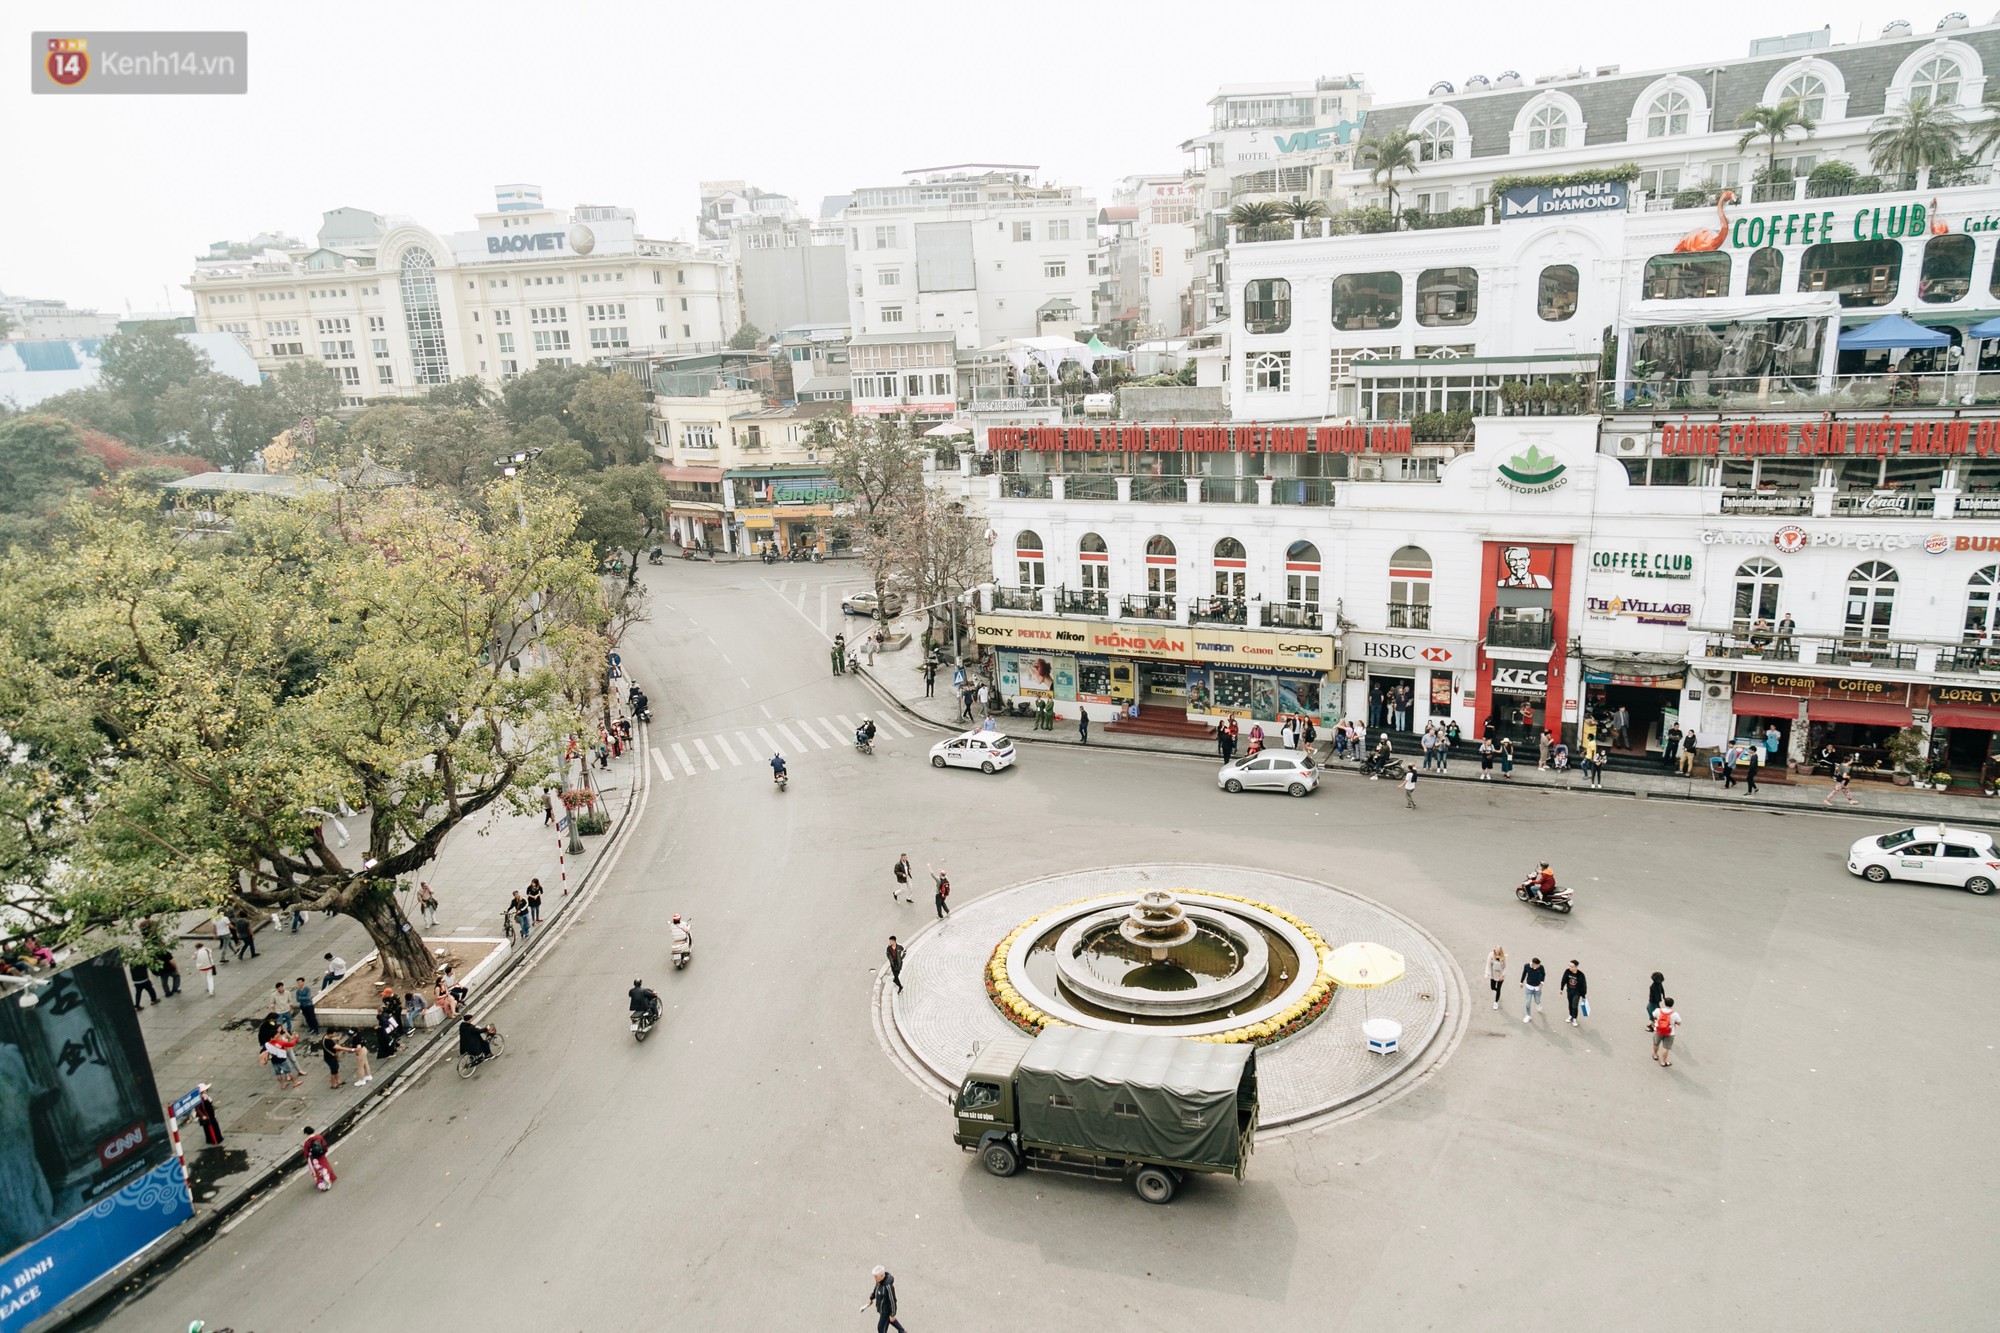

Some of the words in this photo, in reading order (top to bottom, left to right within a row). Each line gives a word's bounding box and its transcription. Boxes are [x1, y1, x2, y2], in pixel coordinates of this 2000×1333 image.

[1238, 152, 1270, 161] HOTEL
[1553, 182, 1611, 199] MINH
[1542, 195, 1621, 212] DIAMOND
[1732, 211, 1834, 249] COFFEE
[1853, 203, 1926, 241] CLUB
[1964, 214, 2000, 233] Café
[487, 232, 566, 254] BAOVIET
[987, 420, 1025, 451] NƯỚC
[1028, 420, 1064, 457] CỘNG
[1100, 421, 1119, 452] XÃ
[1122, 420, 1146, 457] HỘI
[1150, 417, 1179, 452] CHỦ
[1182, 420, 1230, 453] NGHĨA
[1234, 420, 1268, 458] VIỆT
[1271, 426, 1308, 453] NAM
[1316, 420, 1366, 453] MUÔN
[1372, 418, 1412, 453] NĂM
[1662, 414, 1720, 455] ĐẢNG
[1728, 416, 1790, 461] CỘNG
[1799, 412, 1848, 454] SẢN
[1855, 414, 1908, 461] VIỆT
[1910, 421, 1970, 455] NAM
[1495, 476, 1568, 495] PHYTOPHARCO
[1784, 532, 1799, 547] P
[1925, 541, 1948, 550] KING
[1955, 535, 2000, 553] BUR
[1593, 551, 1648, 569] COFFEE
[1654, 553, 1693, 571] CLUB
[1631, 569, 1646, 578] Café
[1655, 571, 1691, 580] Restaurant
[977, 626, 1014, 637] SONY
[1018, 629, 1052, 639] PENTAX
[1055, 631, 1085, 642] Nikon
[1094, 632, 1146, 649] HỒNG
[1148, 637, 1184, 653] VÂN
[1195, 642, 1234, 653] TAMRON
[1241, 645, 1274, 656] Canon
[1278, 643, 1323, 654] GoPro
[1364, 642, 1416, 660] HSBC
[1493, 667, 1548, 685] KFC
[1751, 673, 1768, 684] Ice
[1777, 677, 1815, 688] cream
[1154, 687, 1173, 695] Nikon
[1517, 688, 1547, 697] Kentucky
[1838, 678, 1883, 692] Coffee
[1938, 688, 1983, 702] LONG
[104, 1127, 142, 1160] CNN
[13, 1256, 54, 1289] BÌNH
[0, 1285, 41, 1320] EACE
